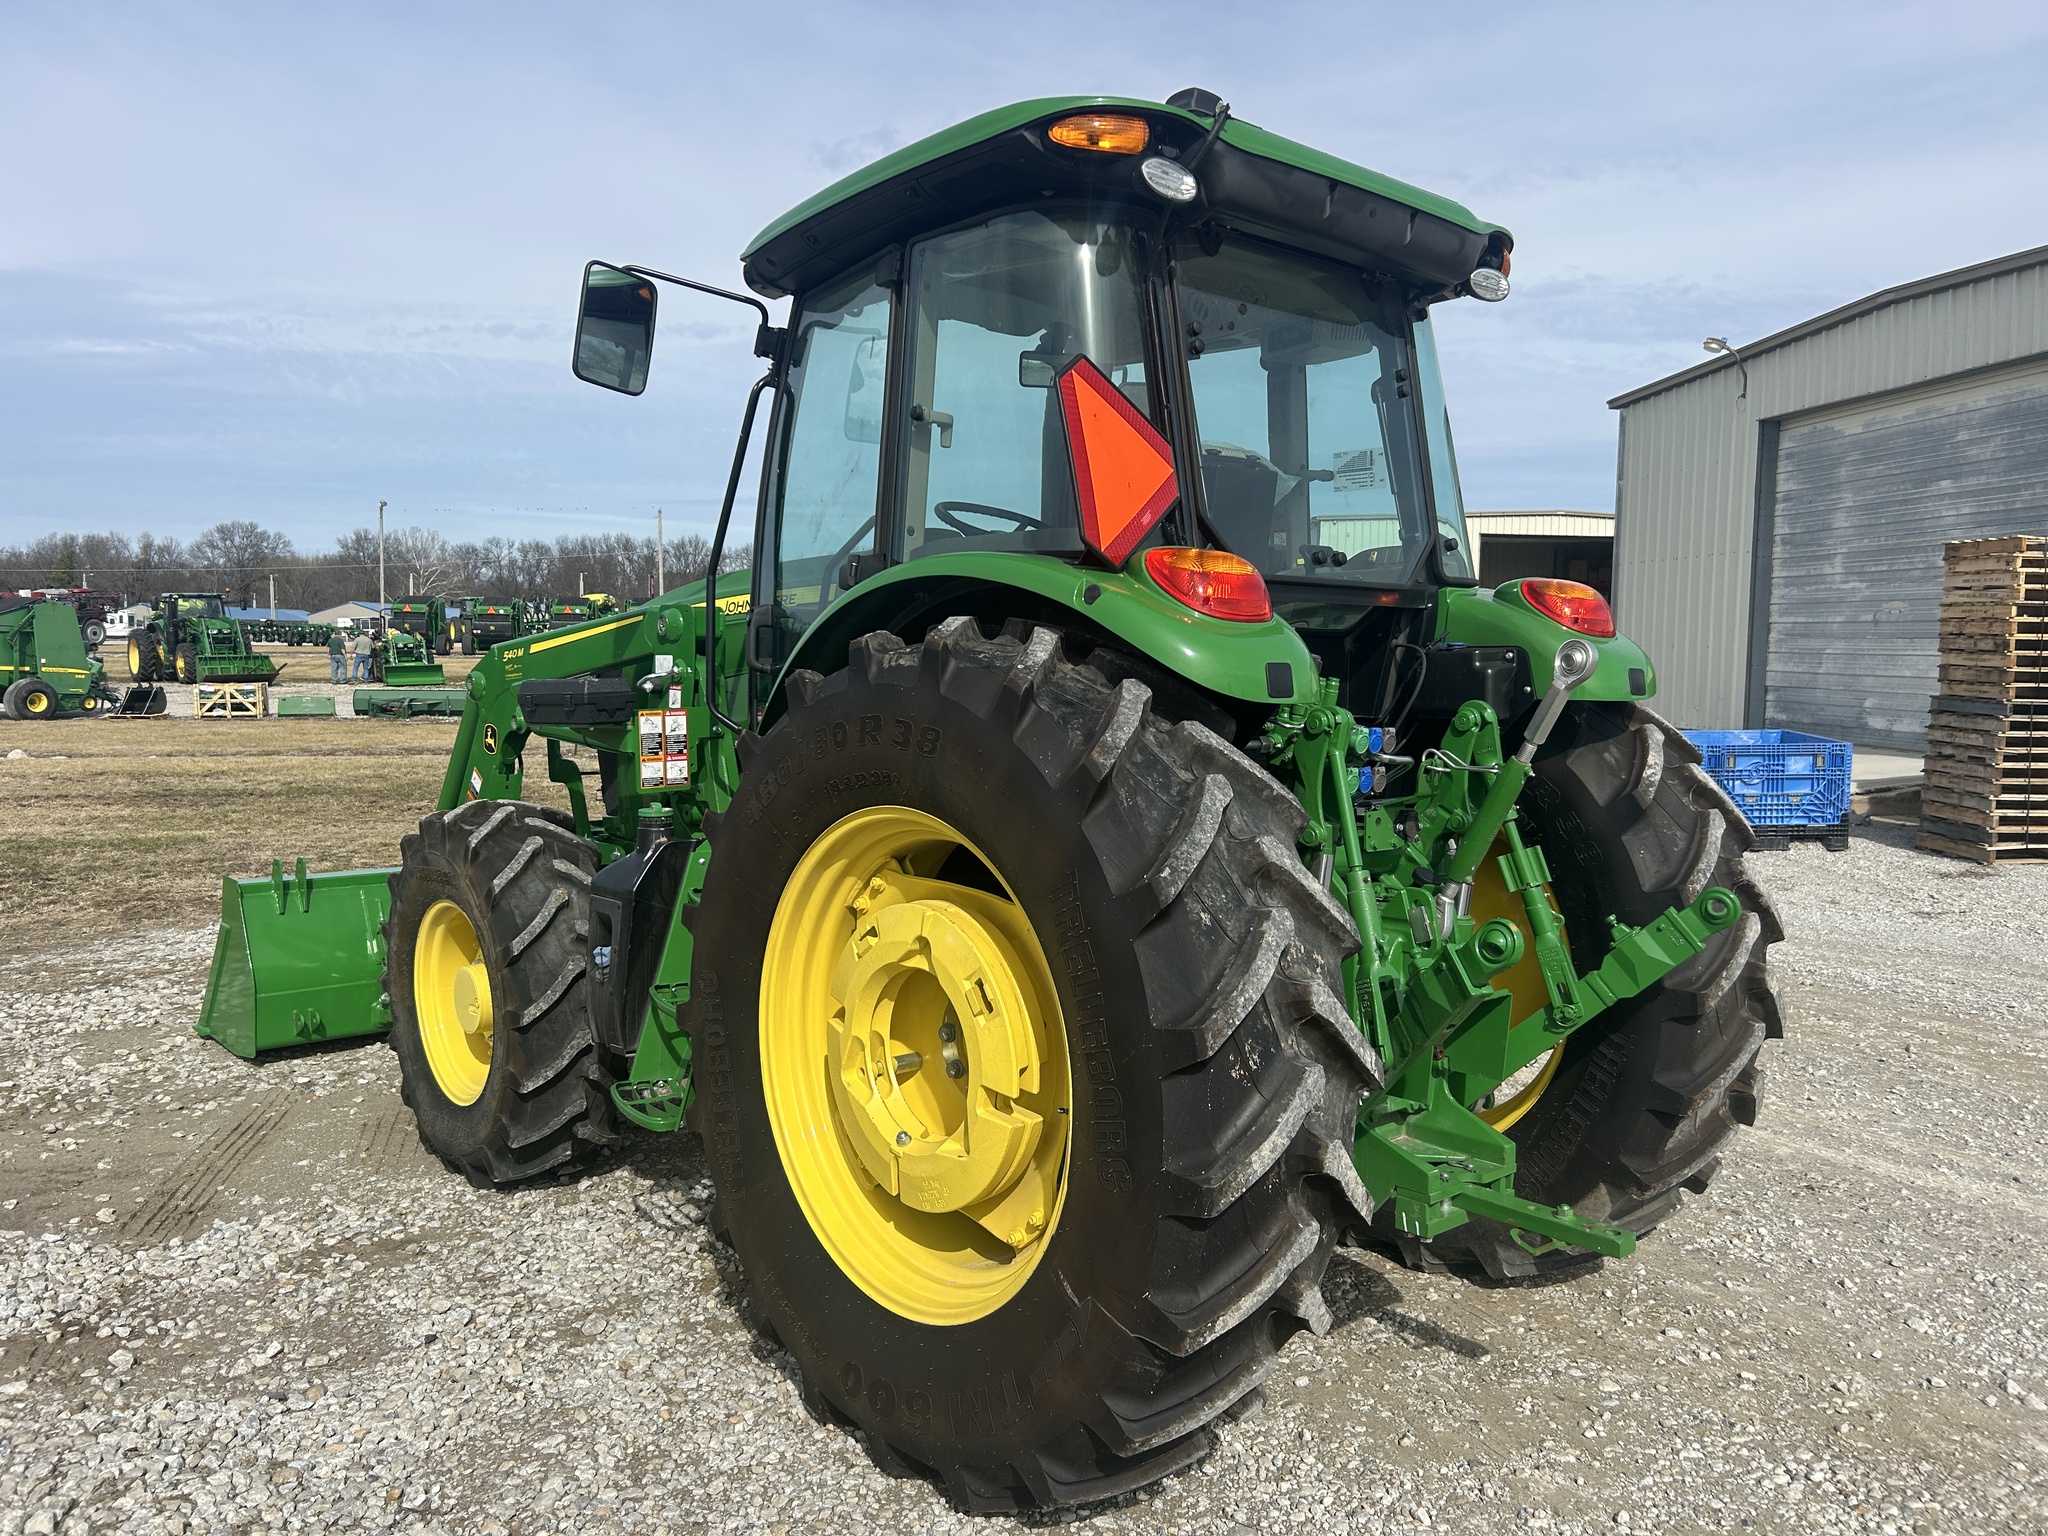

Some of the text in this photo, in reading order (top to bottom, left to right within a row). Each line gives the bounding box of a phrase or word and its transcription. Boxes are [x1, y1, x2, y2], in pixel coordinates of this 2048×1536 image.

[723, 600, 751, 615] JOHN
[857, 714, 885, 747] R
[890, 718, 943, 758] 38
[1049, 868, 1132, 1193] TRELLEBORG
[1515, 1030, 1639, 1200] TRELLEBORG
